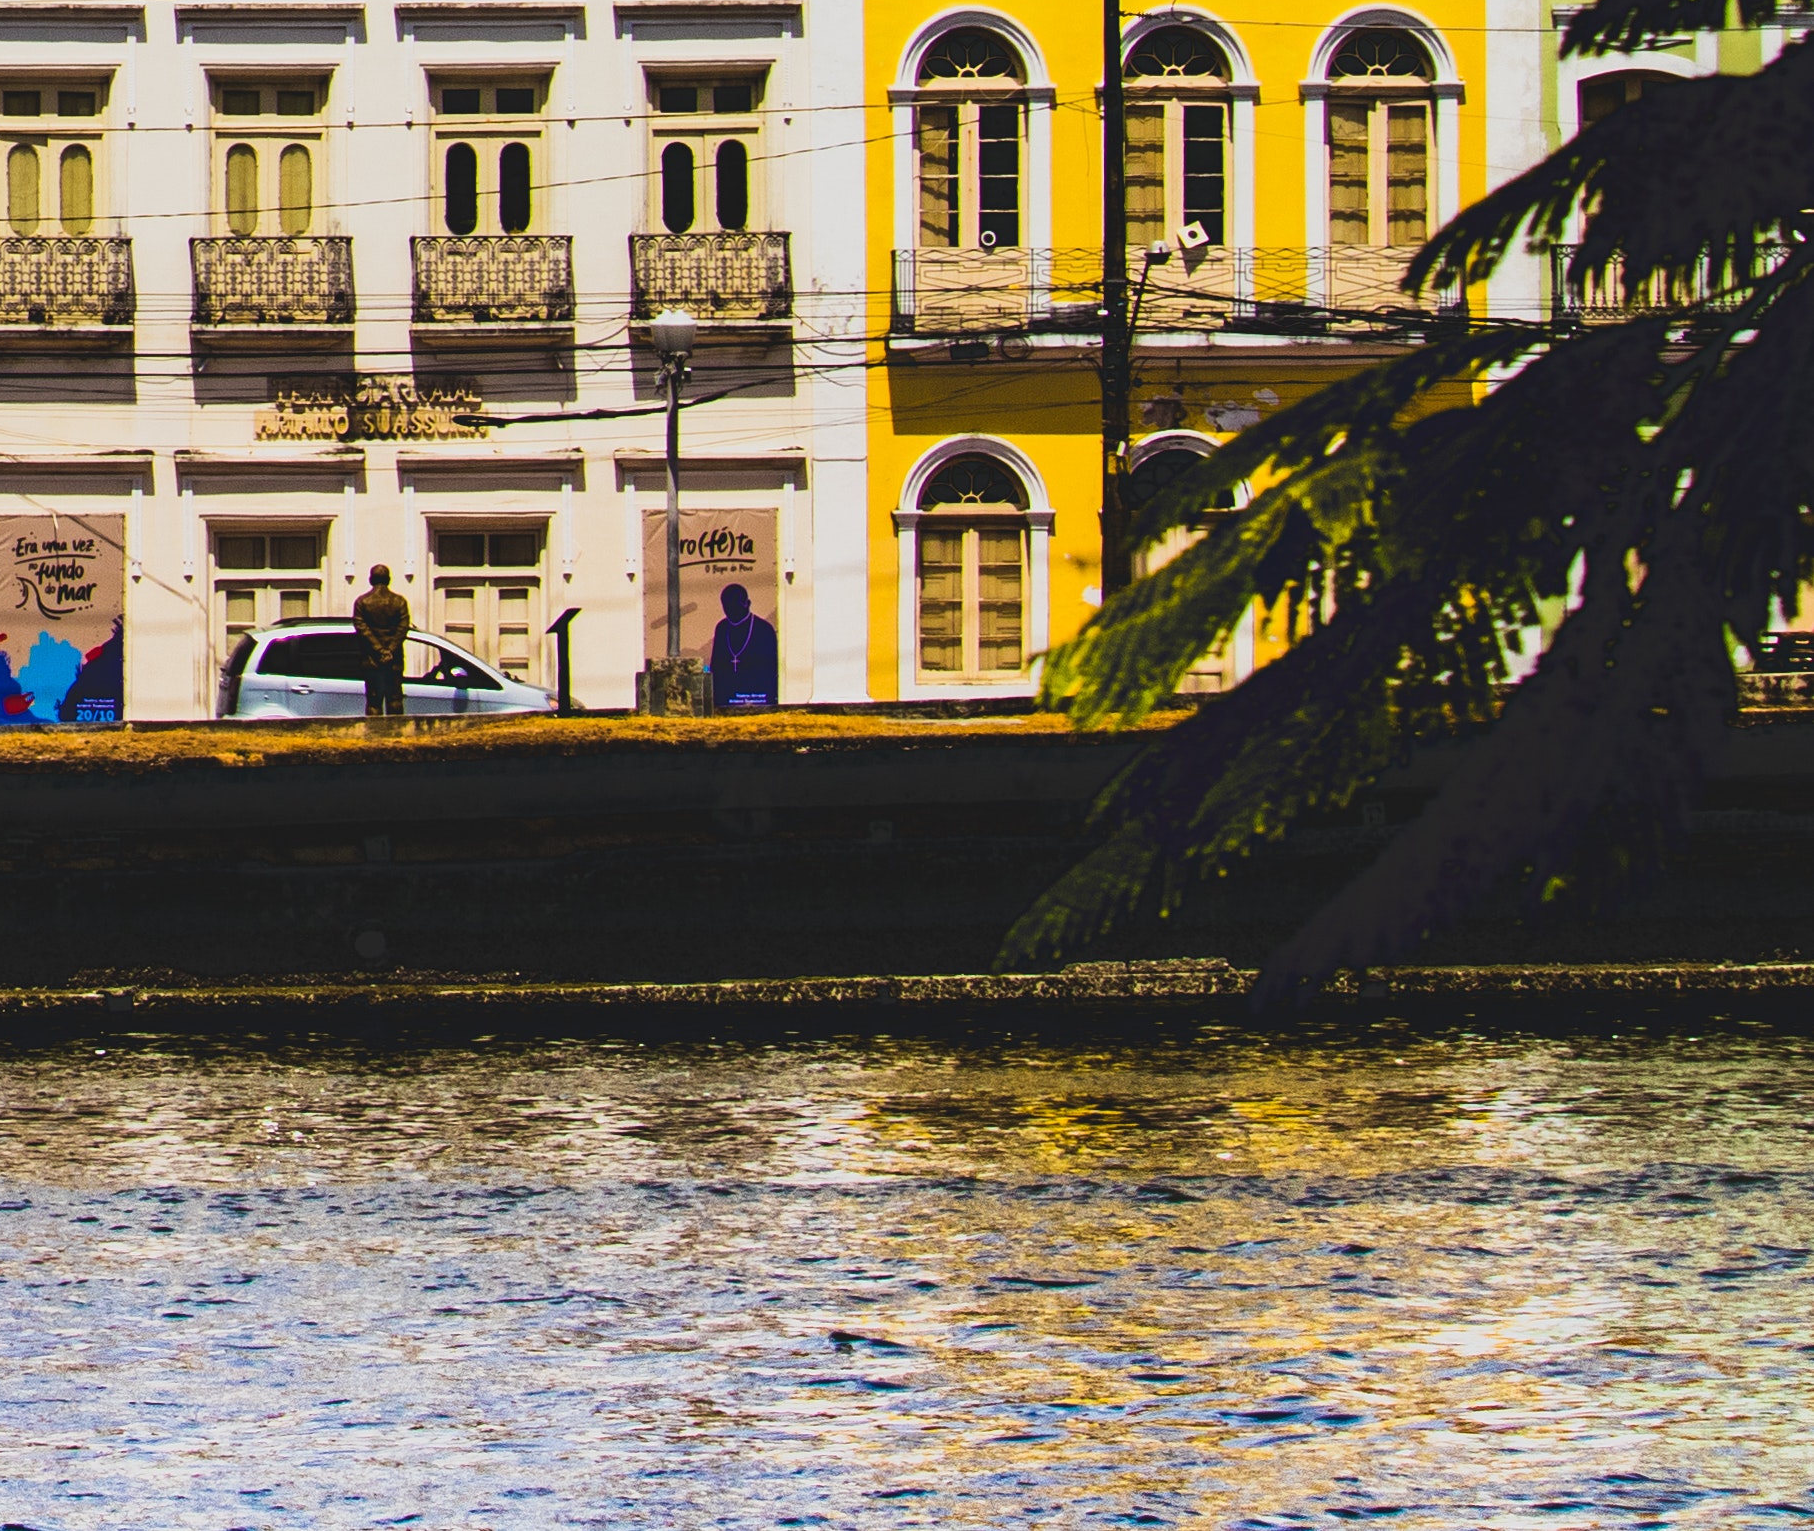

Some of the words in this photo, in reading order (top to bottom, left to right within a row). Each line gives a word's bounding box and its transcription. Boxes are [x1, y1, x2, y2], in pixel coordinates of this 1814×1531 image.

[14, 537, 38, 557] Era
[42, 540, 67, 553] uma
[73, 539, 94, 552] vez
[679, 526, 754, 558] ro(fé)ta
[35, 558, 84, 585] fundo
[57, 583, 97, 604] mar
[76, 709, 115, 721] 20/10
